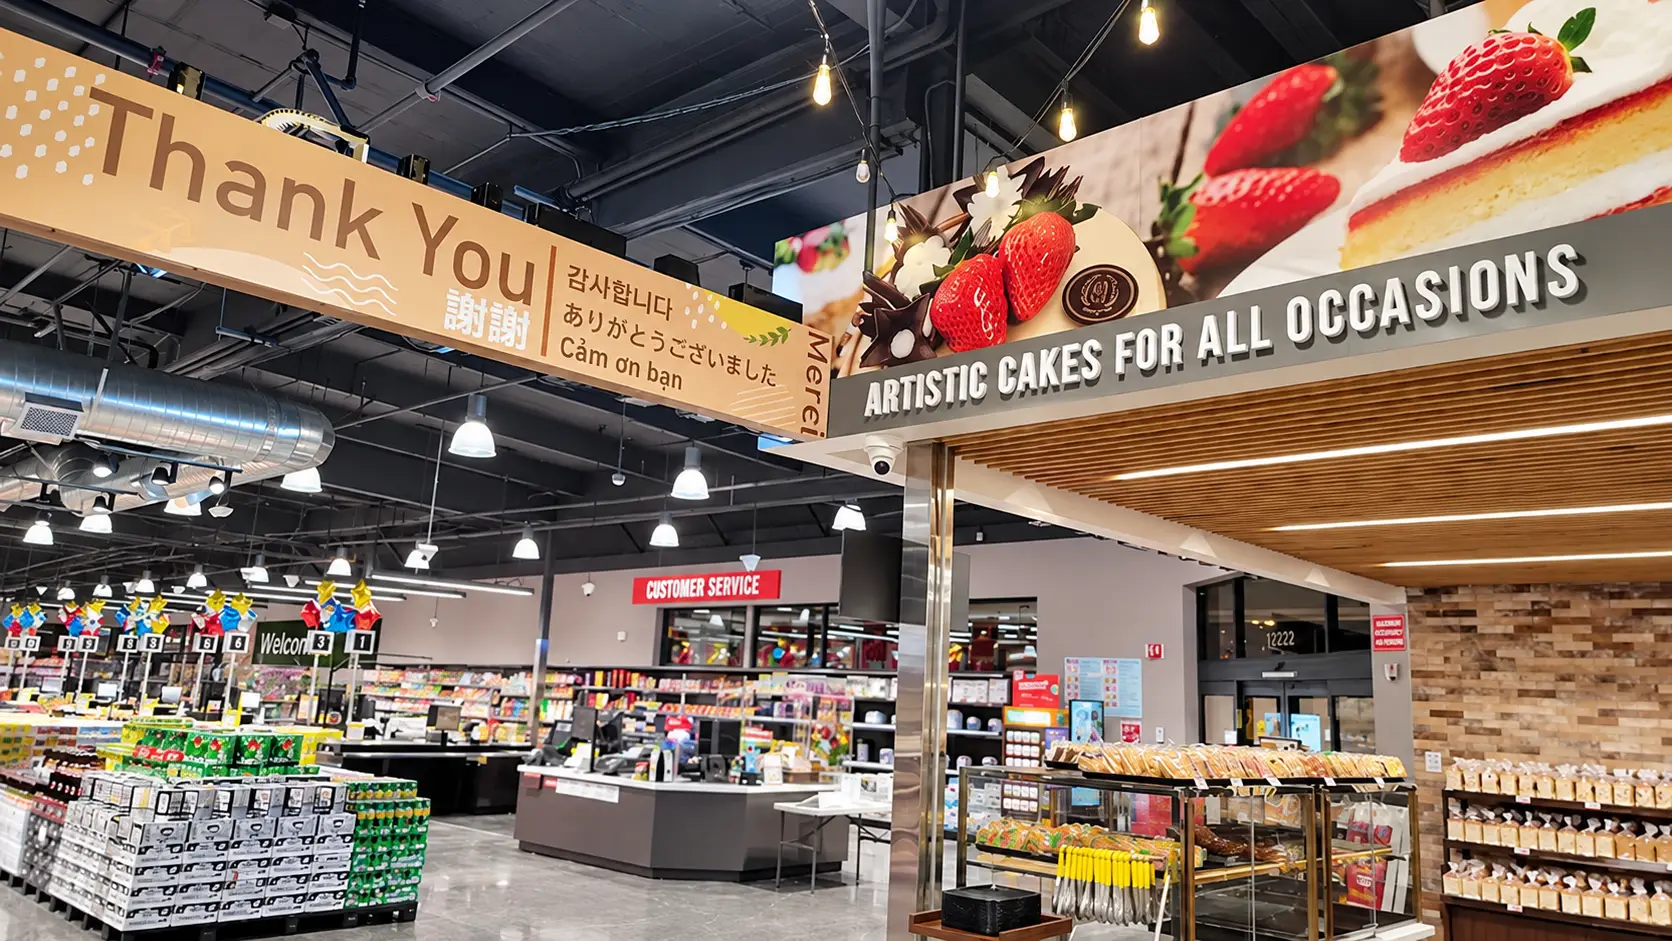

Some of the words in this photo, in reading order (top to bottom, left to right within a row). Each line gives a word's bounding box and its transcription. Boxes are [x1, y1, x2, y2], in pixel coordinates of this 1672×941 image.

[89, 86, 383, 260] Thank
[411, 202, 535, 306] You
[443, 288, 530, 351] 謝謝
[567, 264, 673, 321] 감사합니다
[563, 302, 777, 387] ありがとうございました
[864, 361, 988, 417] ARTISTIC
[998, 339, 1102, 395] CAKES
[1114, 322, 1184, 376] FOR
[1197, 305, 1273, 360] ALL
[1286, 243, 1580, 345] OCCASIONS
[560, 336, 608, 368] Cảm
[615, 355, 640, 378] ơn
[647, 361, 683, 391] bạn
[646, 578, 705, 599] CUSTOMER
[707, 575, 760, 596] SERVICE
[234, 637, 242, 649] 6
[261, 631, 310, 655] Welcom
[317, 635, 325, 649] 3
[1266, 630, 1295, 647] 12222
